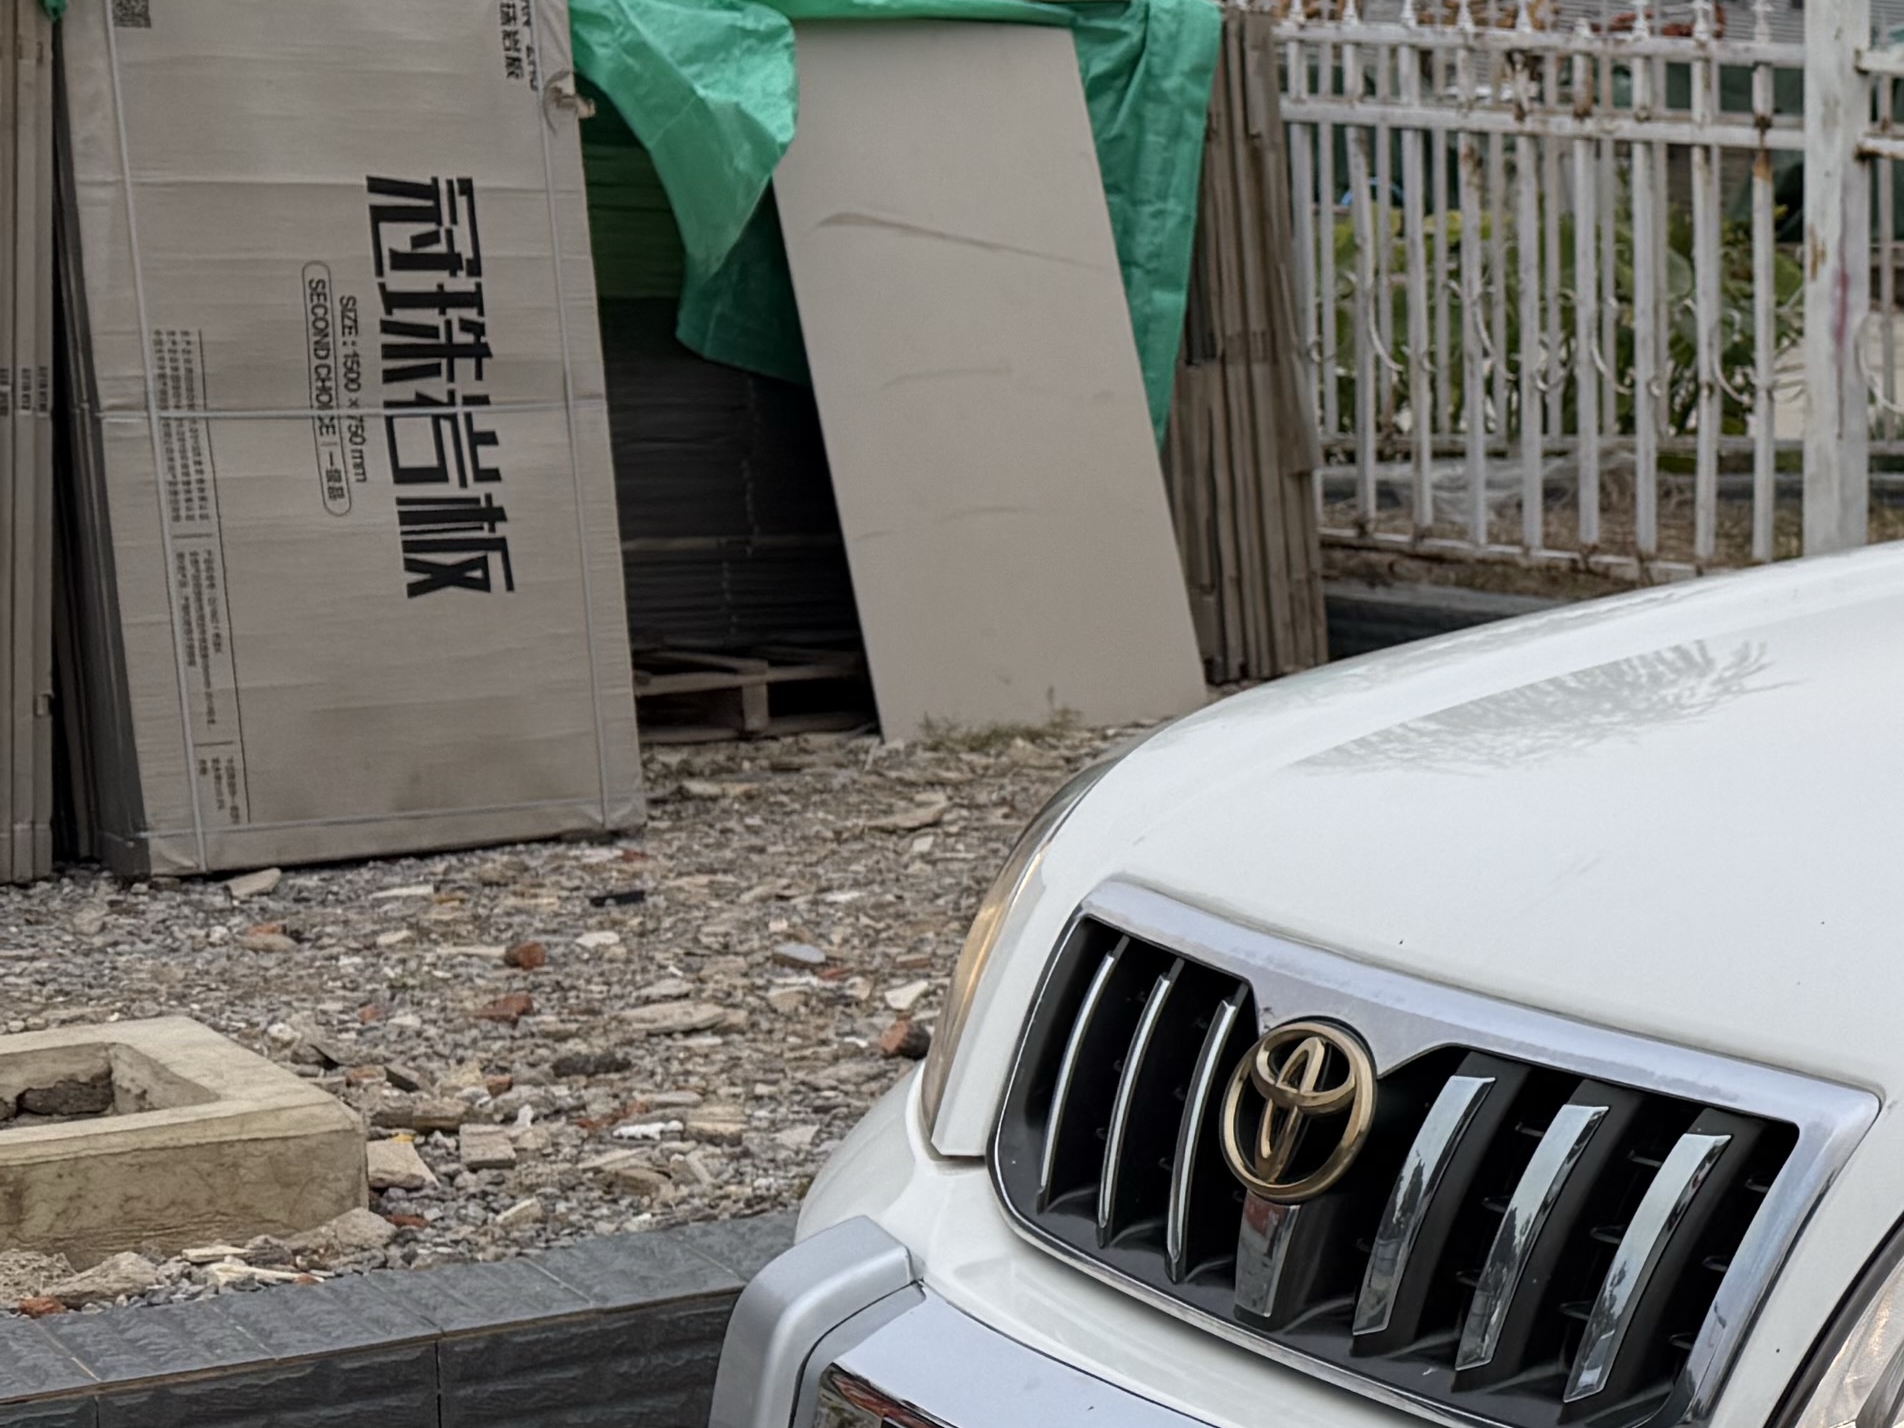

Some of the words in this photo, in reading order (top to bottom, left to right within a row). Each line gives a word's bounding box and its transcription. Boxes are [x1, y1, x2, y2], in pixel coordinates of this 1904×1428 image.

[308, 277, 331, 361] SECOND
[346, 348, 361, 393] 1500
[366, 174, 515, 599] 冠珠岩板
